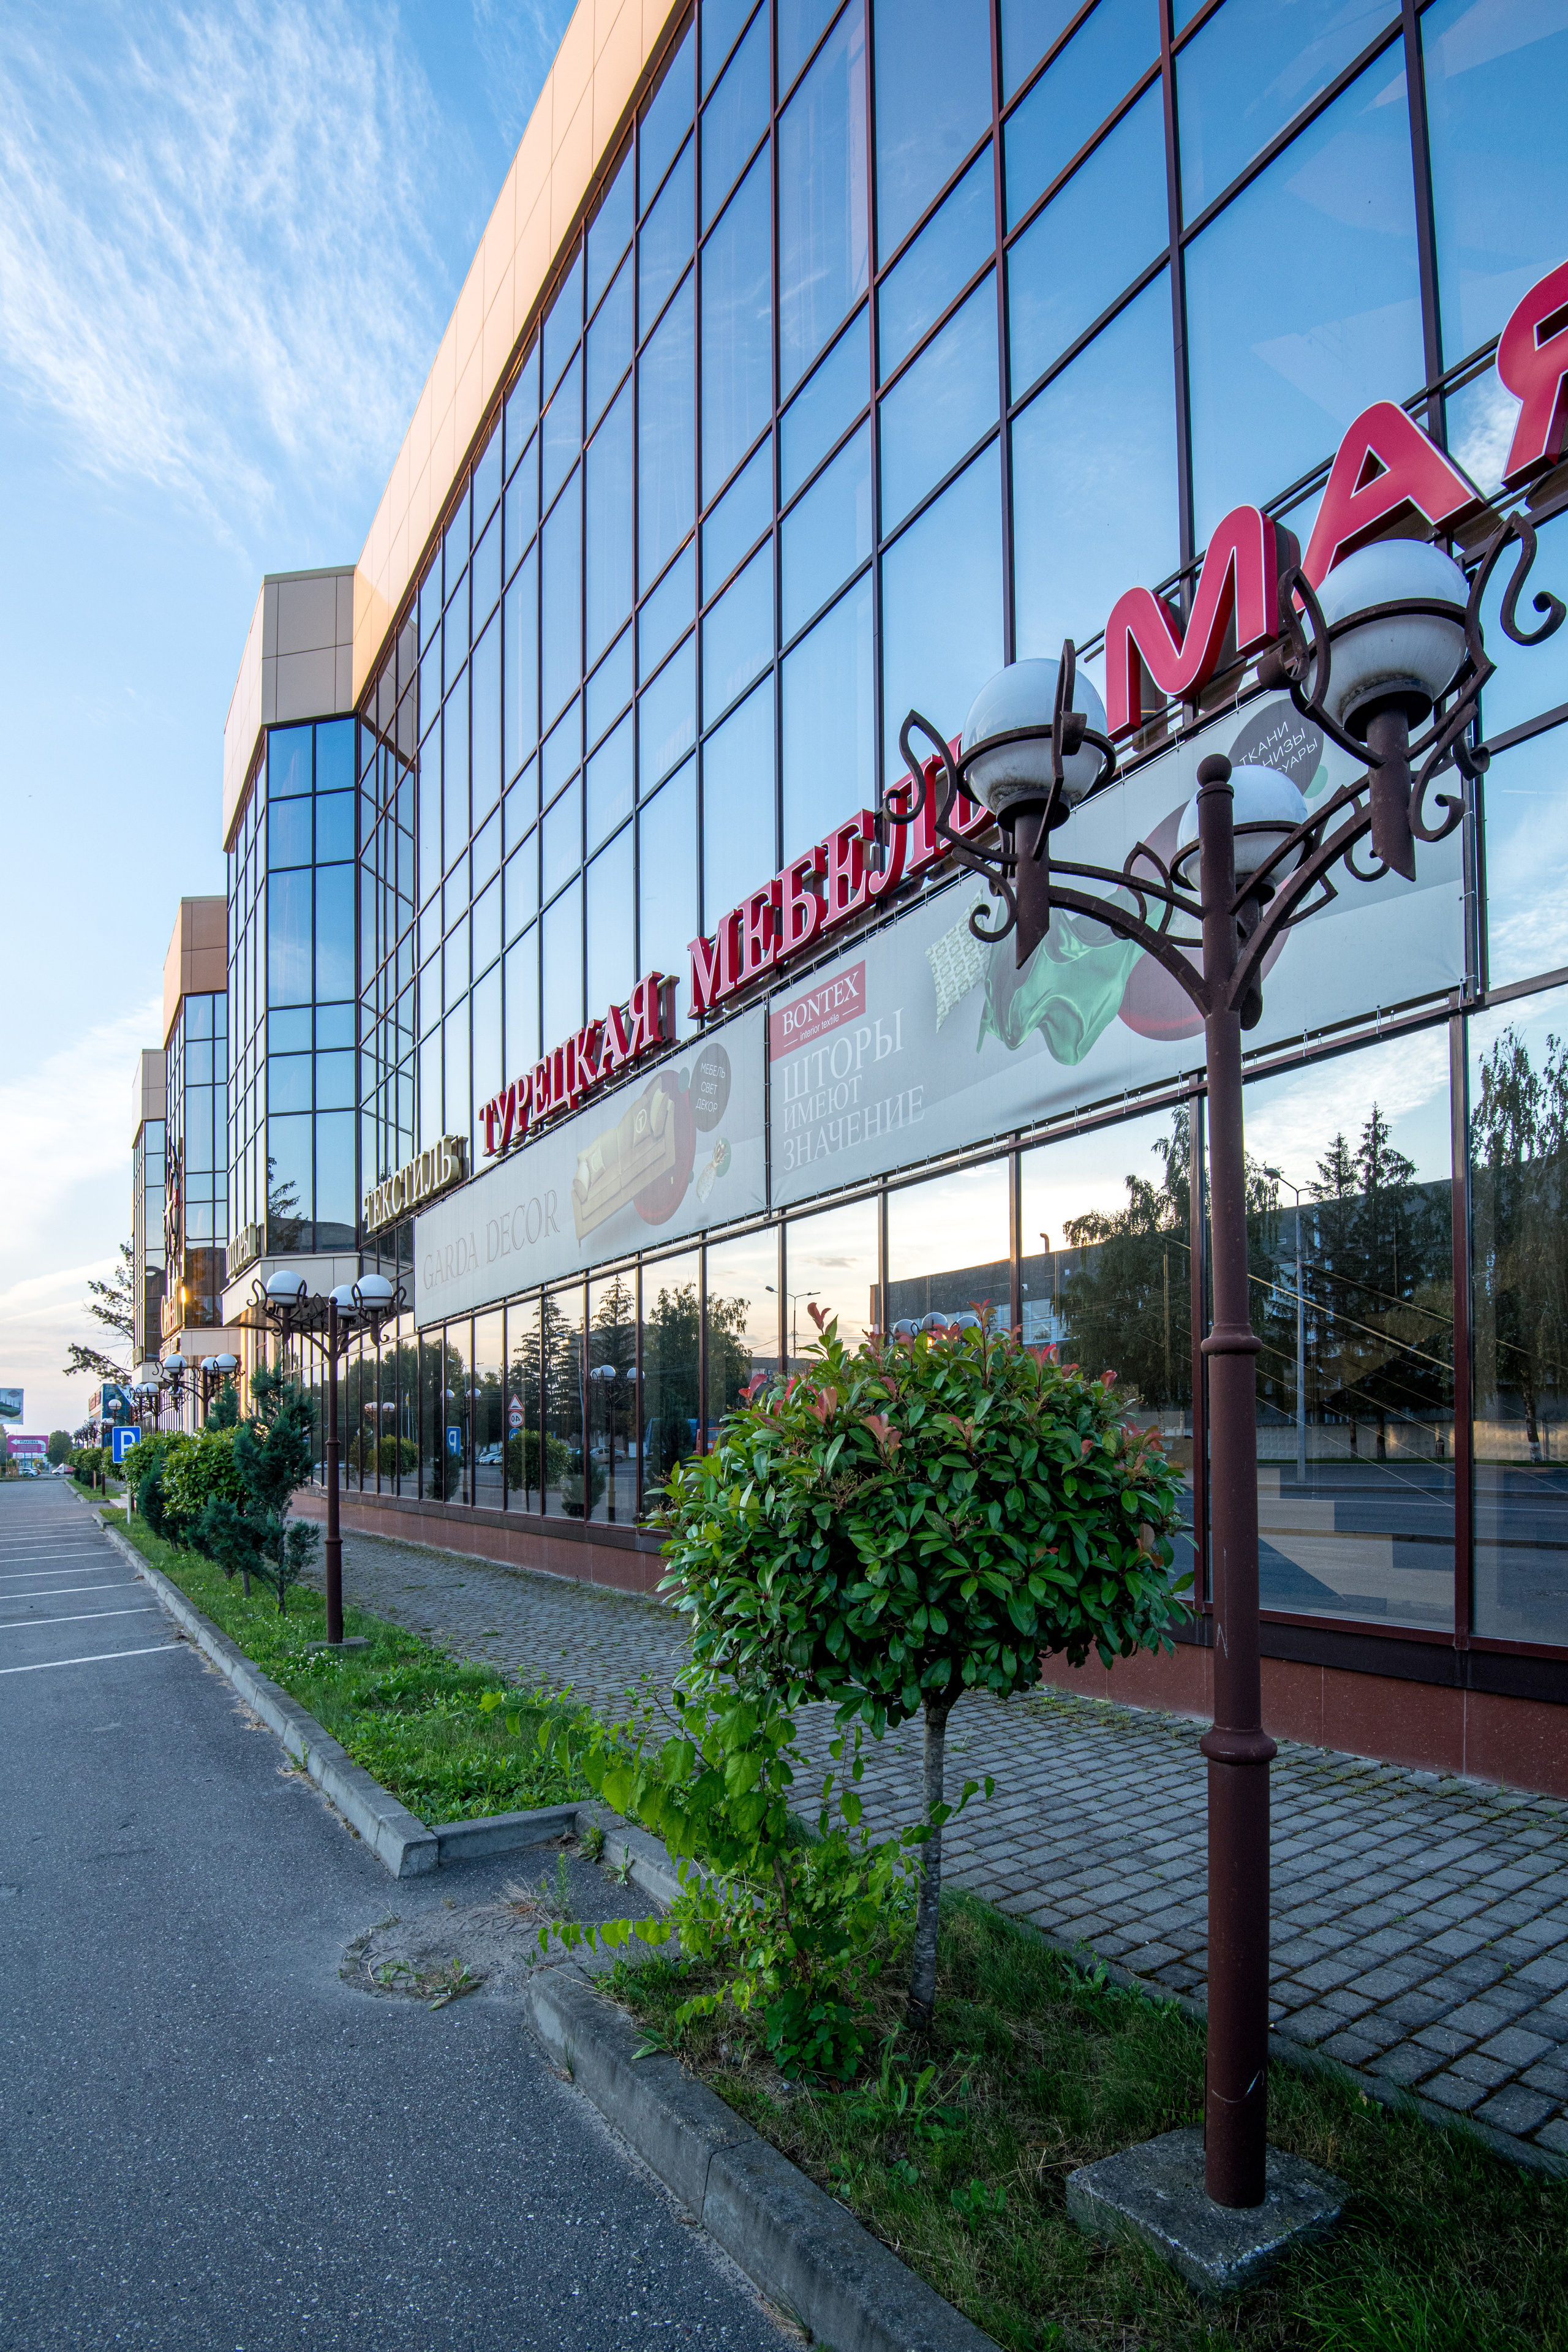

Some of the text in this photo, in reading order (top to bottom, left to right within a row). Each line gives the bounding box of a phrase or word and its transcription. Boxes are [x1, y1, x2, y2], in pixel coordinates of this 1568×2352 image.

[1239, 721, 1289, 766] ТКАНИ
[782, 971, 859, 1036] BONTEX
[800, 1013, 839, 1041] interior textile
[479, 971, 663, 1157] ТУРЕЦКАЯ
[700, 1063, 726, 1079] МЕБЕЛЬ
[782, 1008, 904, 1104] ШТОРЫ
[695, 1098, 718, 1113] ДЕКОР
[701, 1081, 718, 1095] СВЕТ
[783, 1074, 862, 1133] ИМЕЮТ
[783, 1085, 925, 1171] ЗНАЧЕНИЕ
[364, 1134, 456, 1233] ТЕКСТИЛЬ
[225, 1222, 254, 1279] ШТОРЫ
[423, 1189, 560, 1290] GARDA DECOR
[121, 1431, 135, 1458] P
